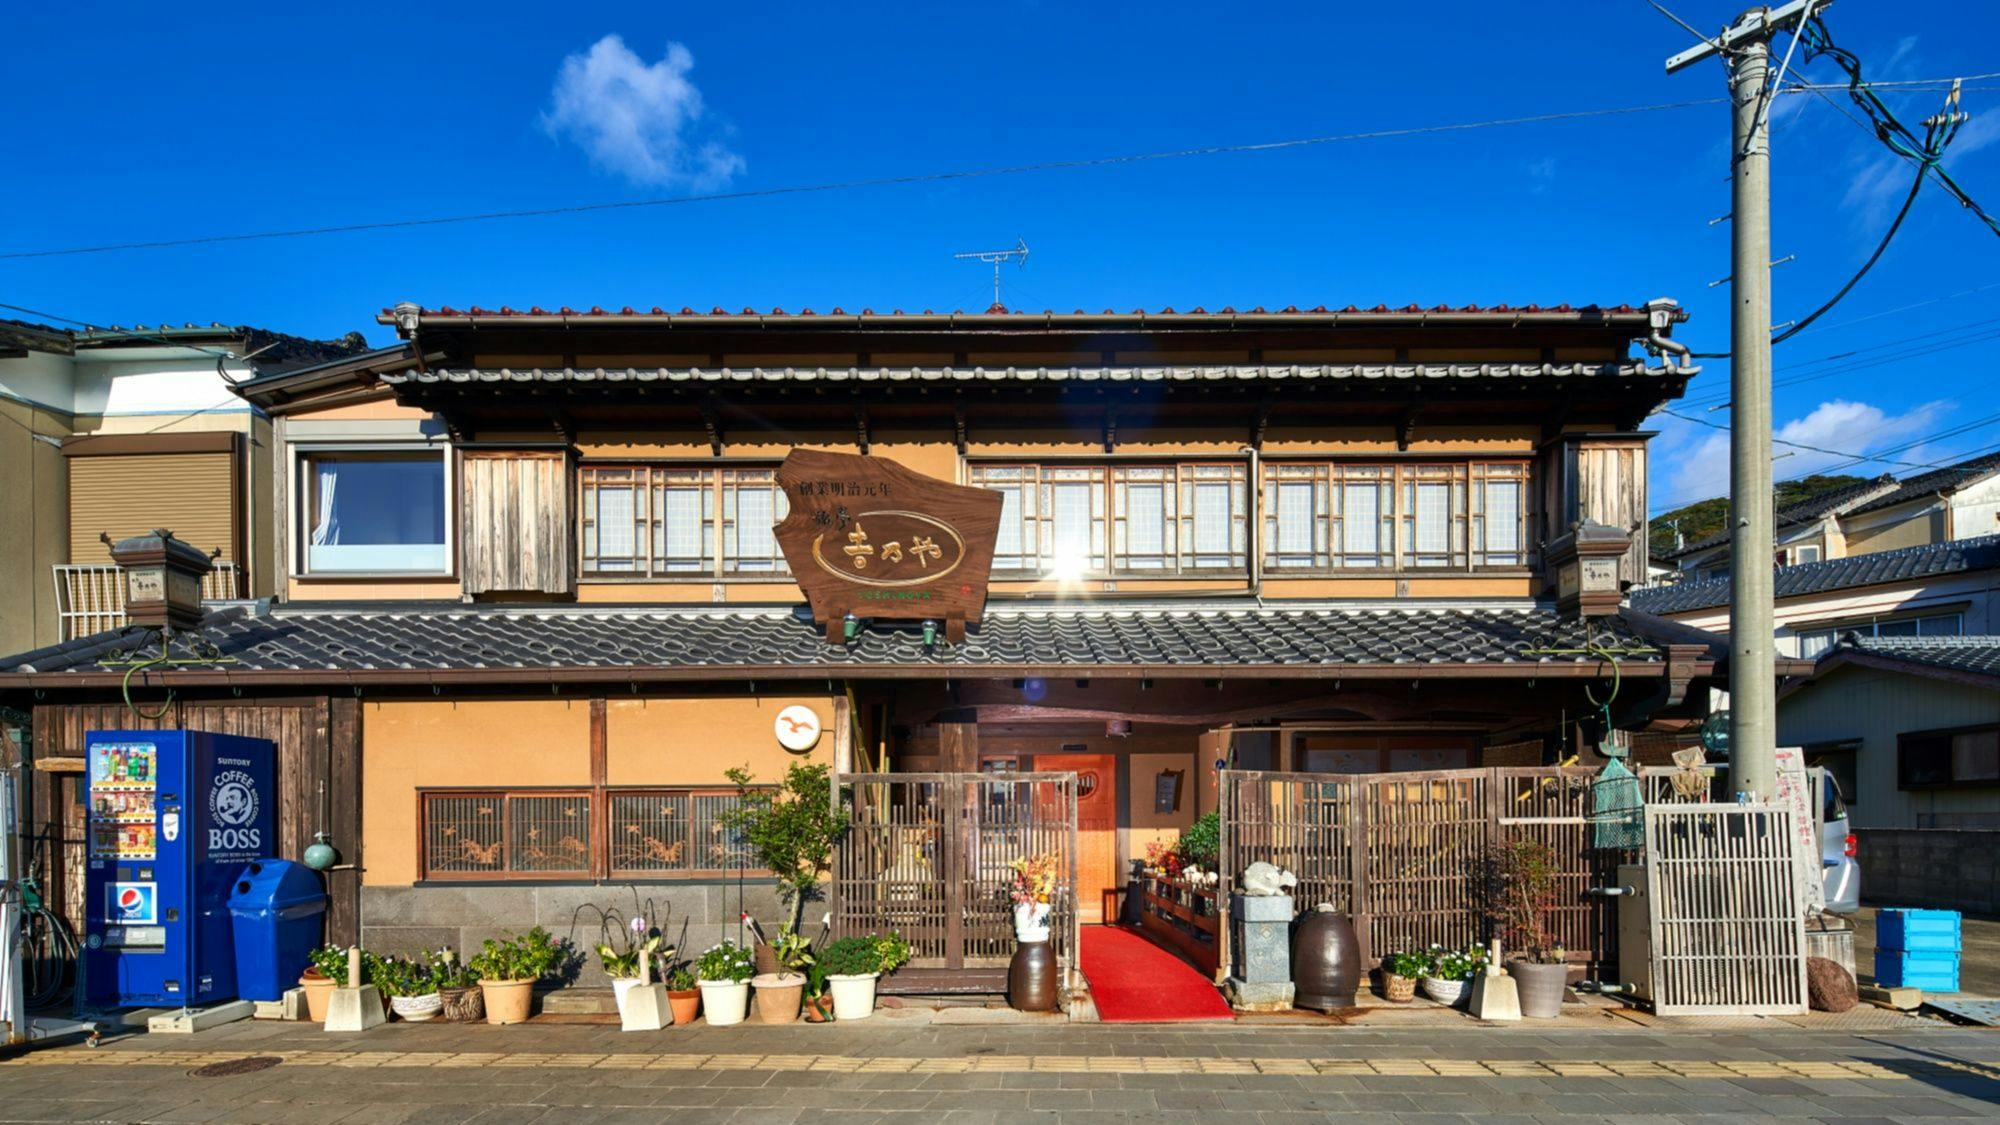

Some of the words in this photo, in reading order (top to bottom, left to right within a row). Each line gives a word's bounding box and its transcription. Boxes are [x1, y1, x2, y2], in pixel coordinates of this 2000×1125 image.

[799, 481, 893, 497] 創業明治元年
[214, 770, 255, 788] COFFEE
[208, 828, 260, 850] BOSS
